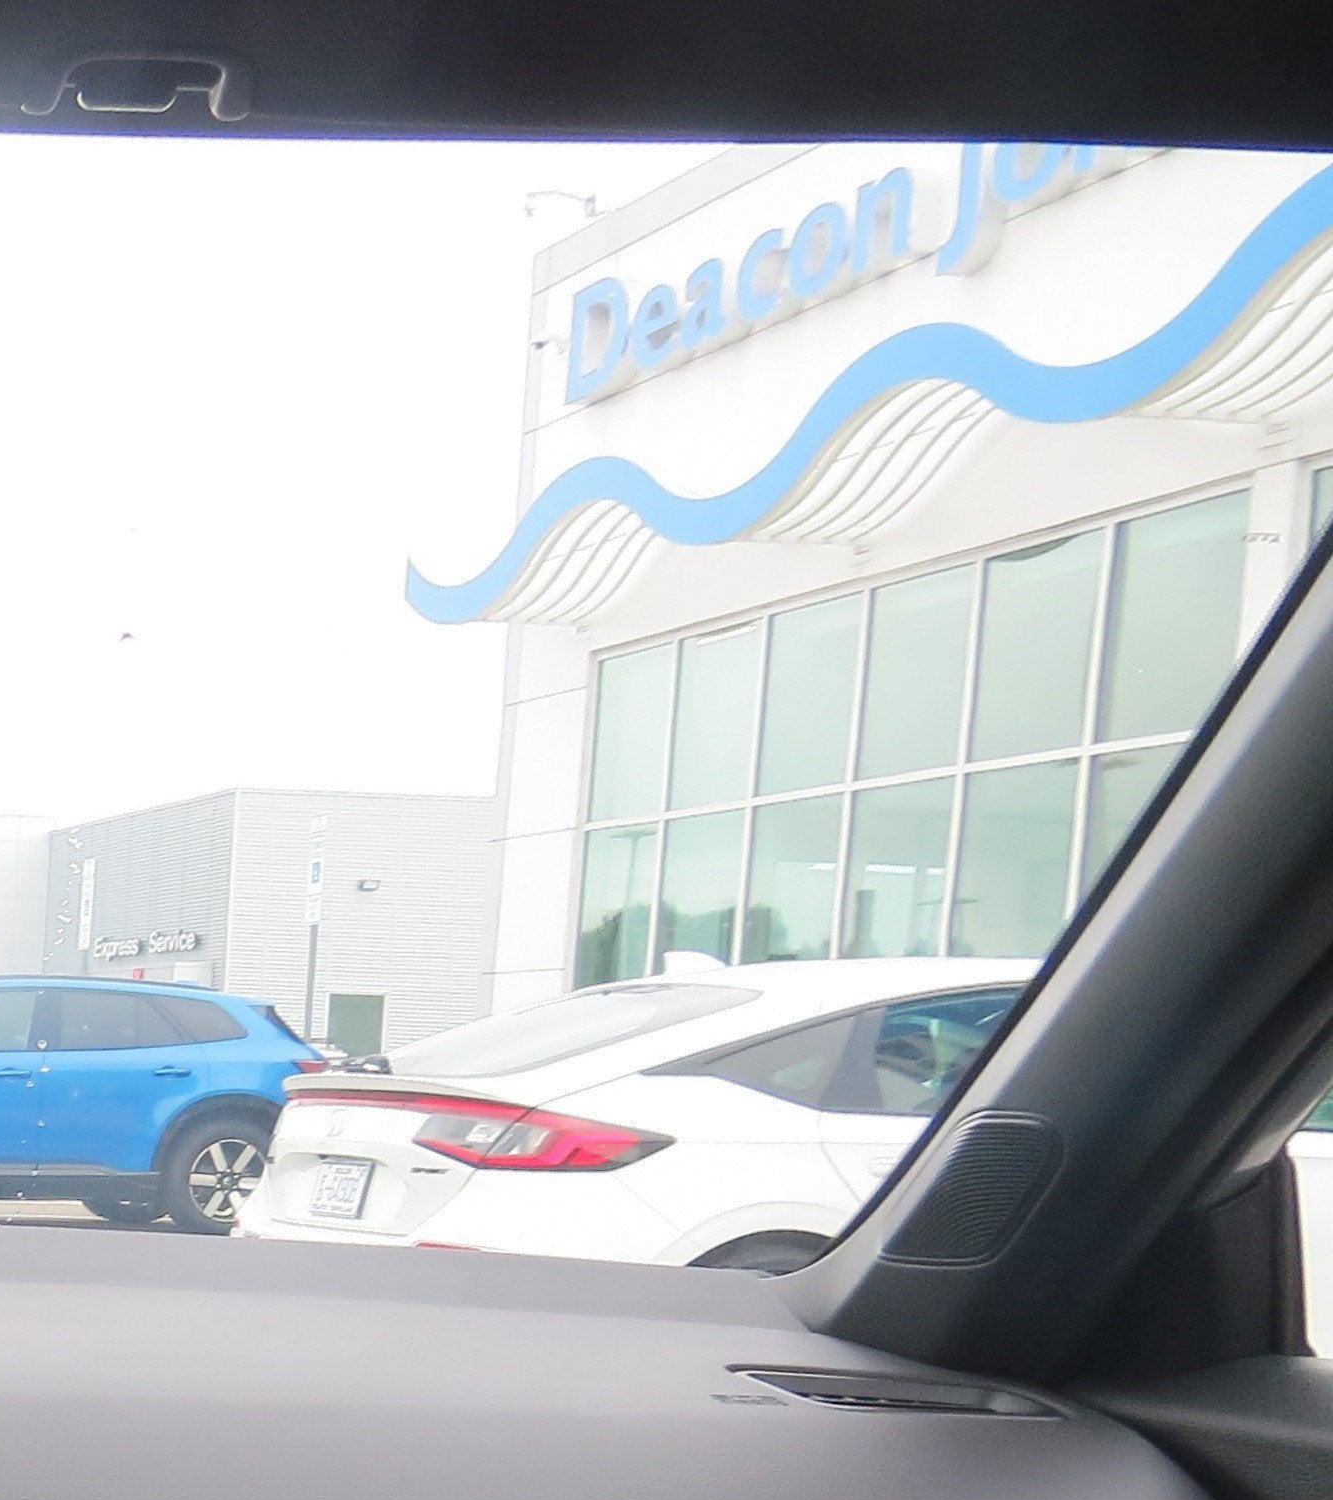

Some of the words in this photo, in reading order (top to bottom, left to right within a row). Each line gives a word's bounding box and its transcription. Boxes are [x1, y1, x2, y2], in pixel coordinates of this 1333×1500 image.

[566, 165, 917, 404] Deacon
[936, 143, 1096, 276] Jo
[93, 935, 141, 961] Express
[148, 929, 200, 954] Service
